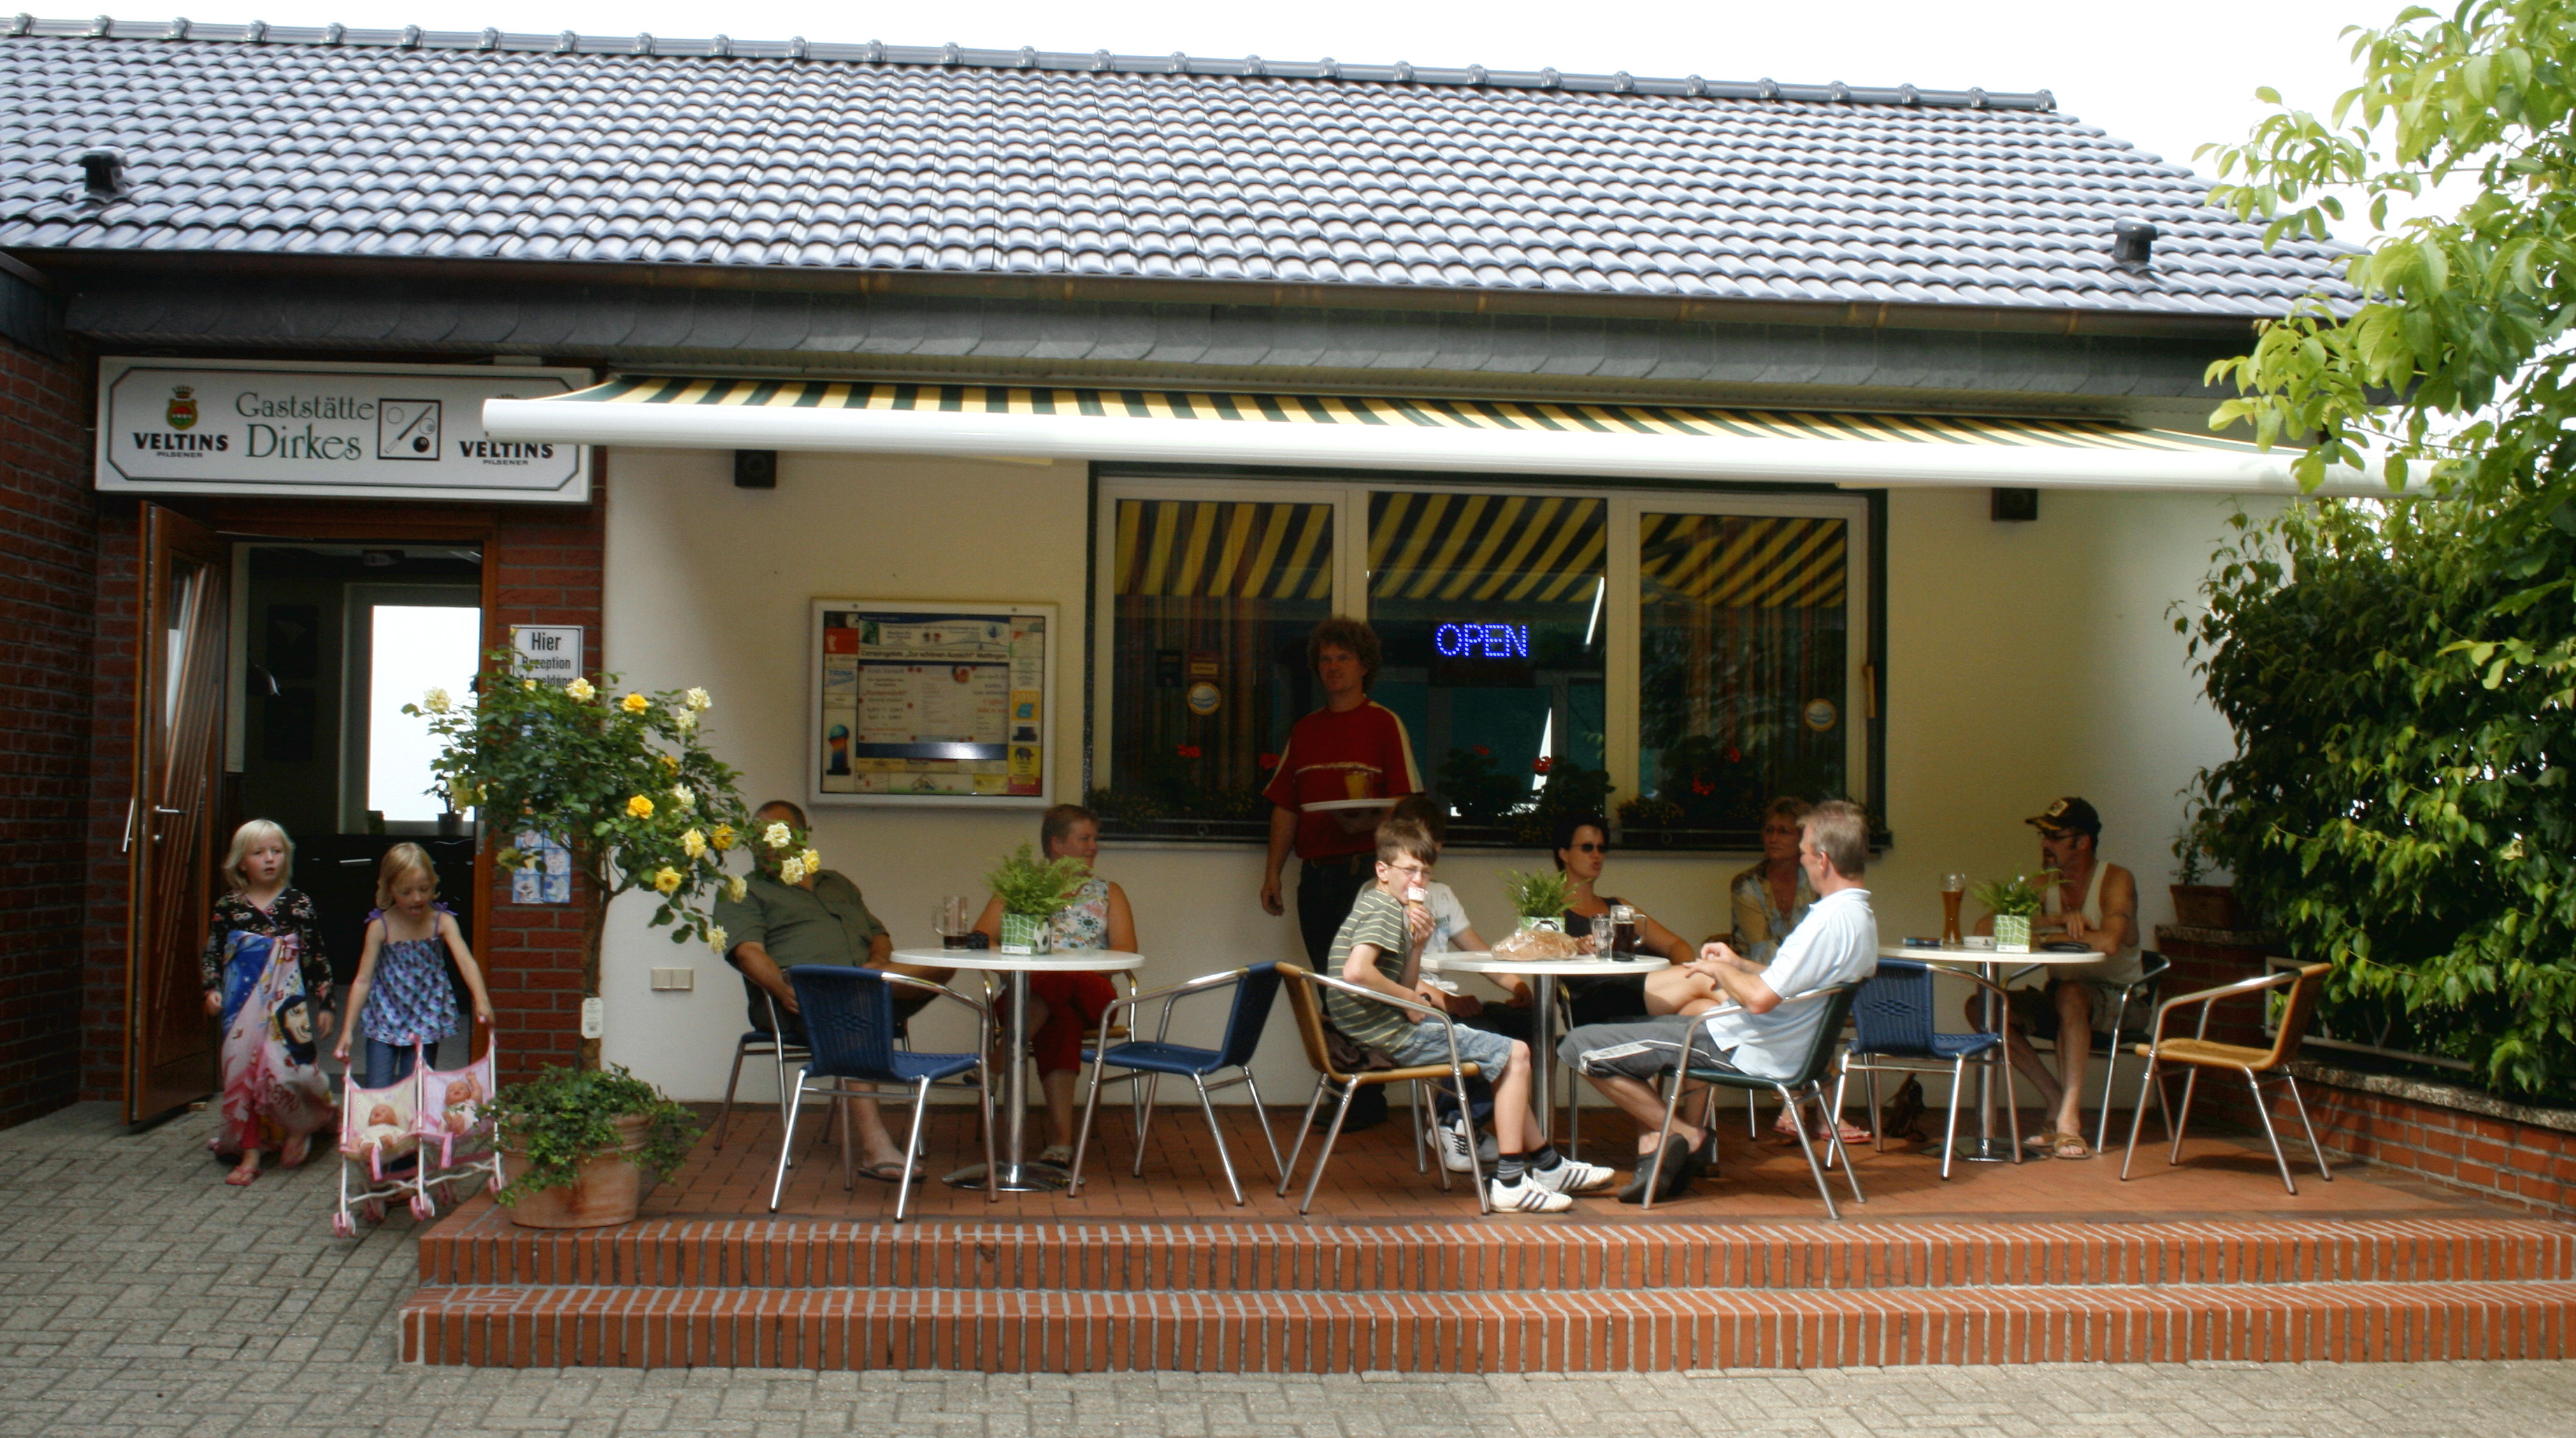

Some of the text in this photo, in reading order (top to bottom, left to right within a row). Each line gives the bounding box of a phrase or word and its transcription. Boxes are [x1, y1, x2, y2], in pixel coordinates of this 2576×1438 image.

[236, 391, 375, 420] Gaststätte
[132, 432, 229, 452] VELTINS
[246, 422, 362, 461] Dirkes
[459, 440, 554, 459] VELTINS
[531, 631, 561, 651] Hier
[1437, 622, 1528, 657] OPEN
